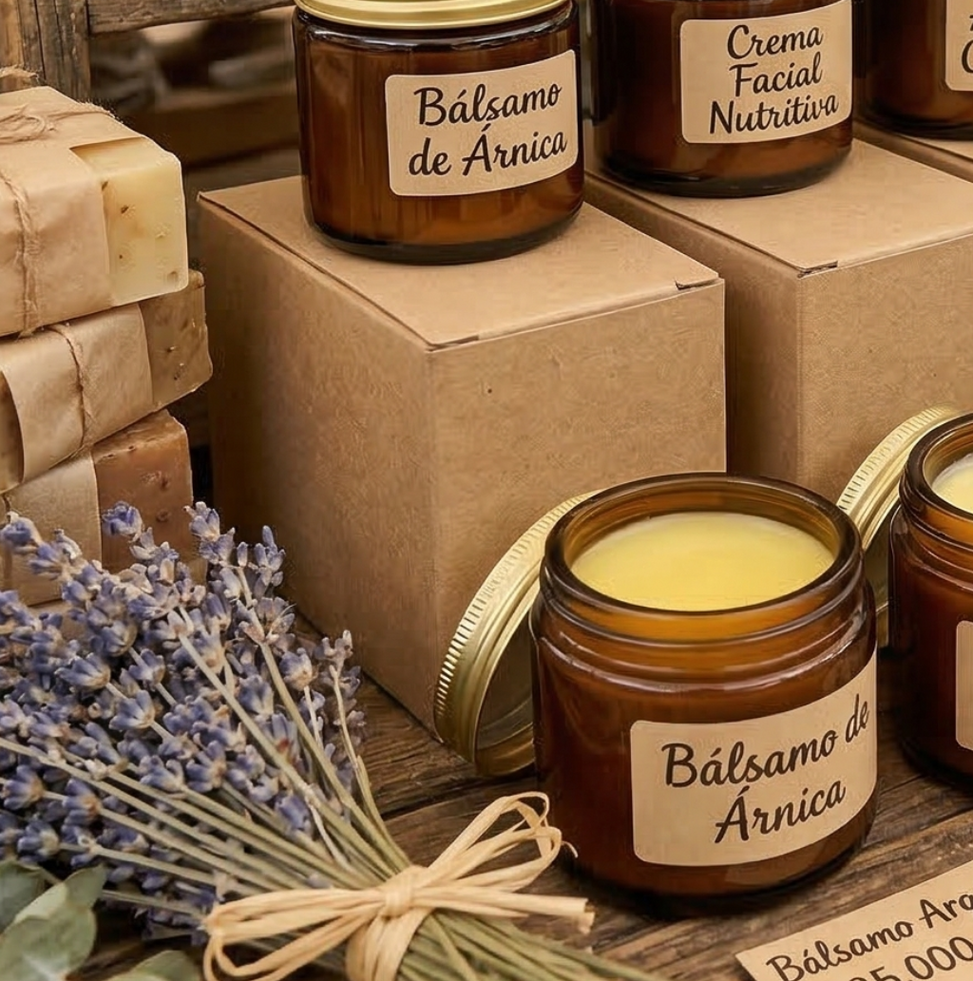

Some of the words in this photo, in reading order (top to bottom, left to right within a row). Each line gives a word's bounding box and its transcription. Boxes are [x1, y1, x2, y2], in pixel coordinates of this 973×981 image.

[726, 23, 824, 61] Crema
[730, 51, 823, 98] Facial
[413, 82, 562, 126] Bálsamo
[709, 94, 840, 135] Nutritiva
[408, 137, 451, 177] de
[462, 117, 568, 177] Árnica
[660, 728, 838, 788] Bálsamo
[844, 693, 870, 745] de
[713, 776, 848, 844] Árnica
[765, 920, 915, 981] Bálsamo
